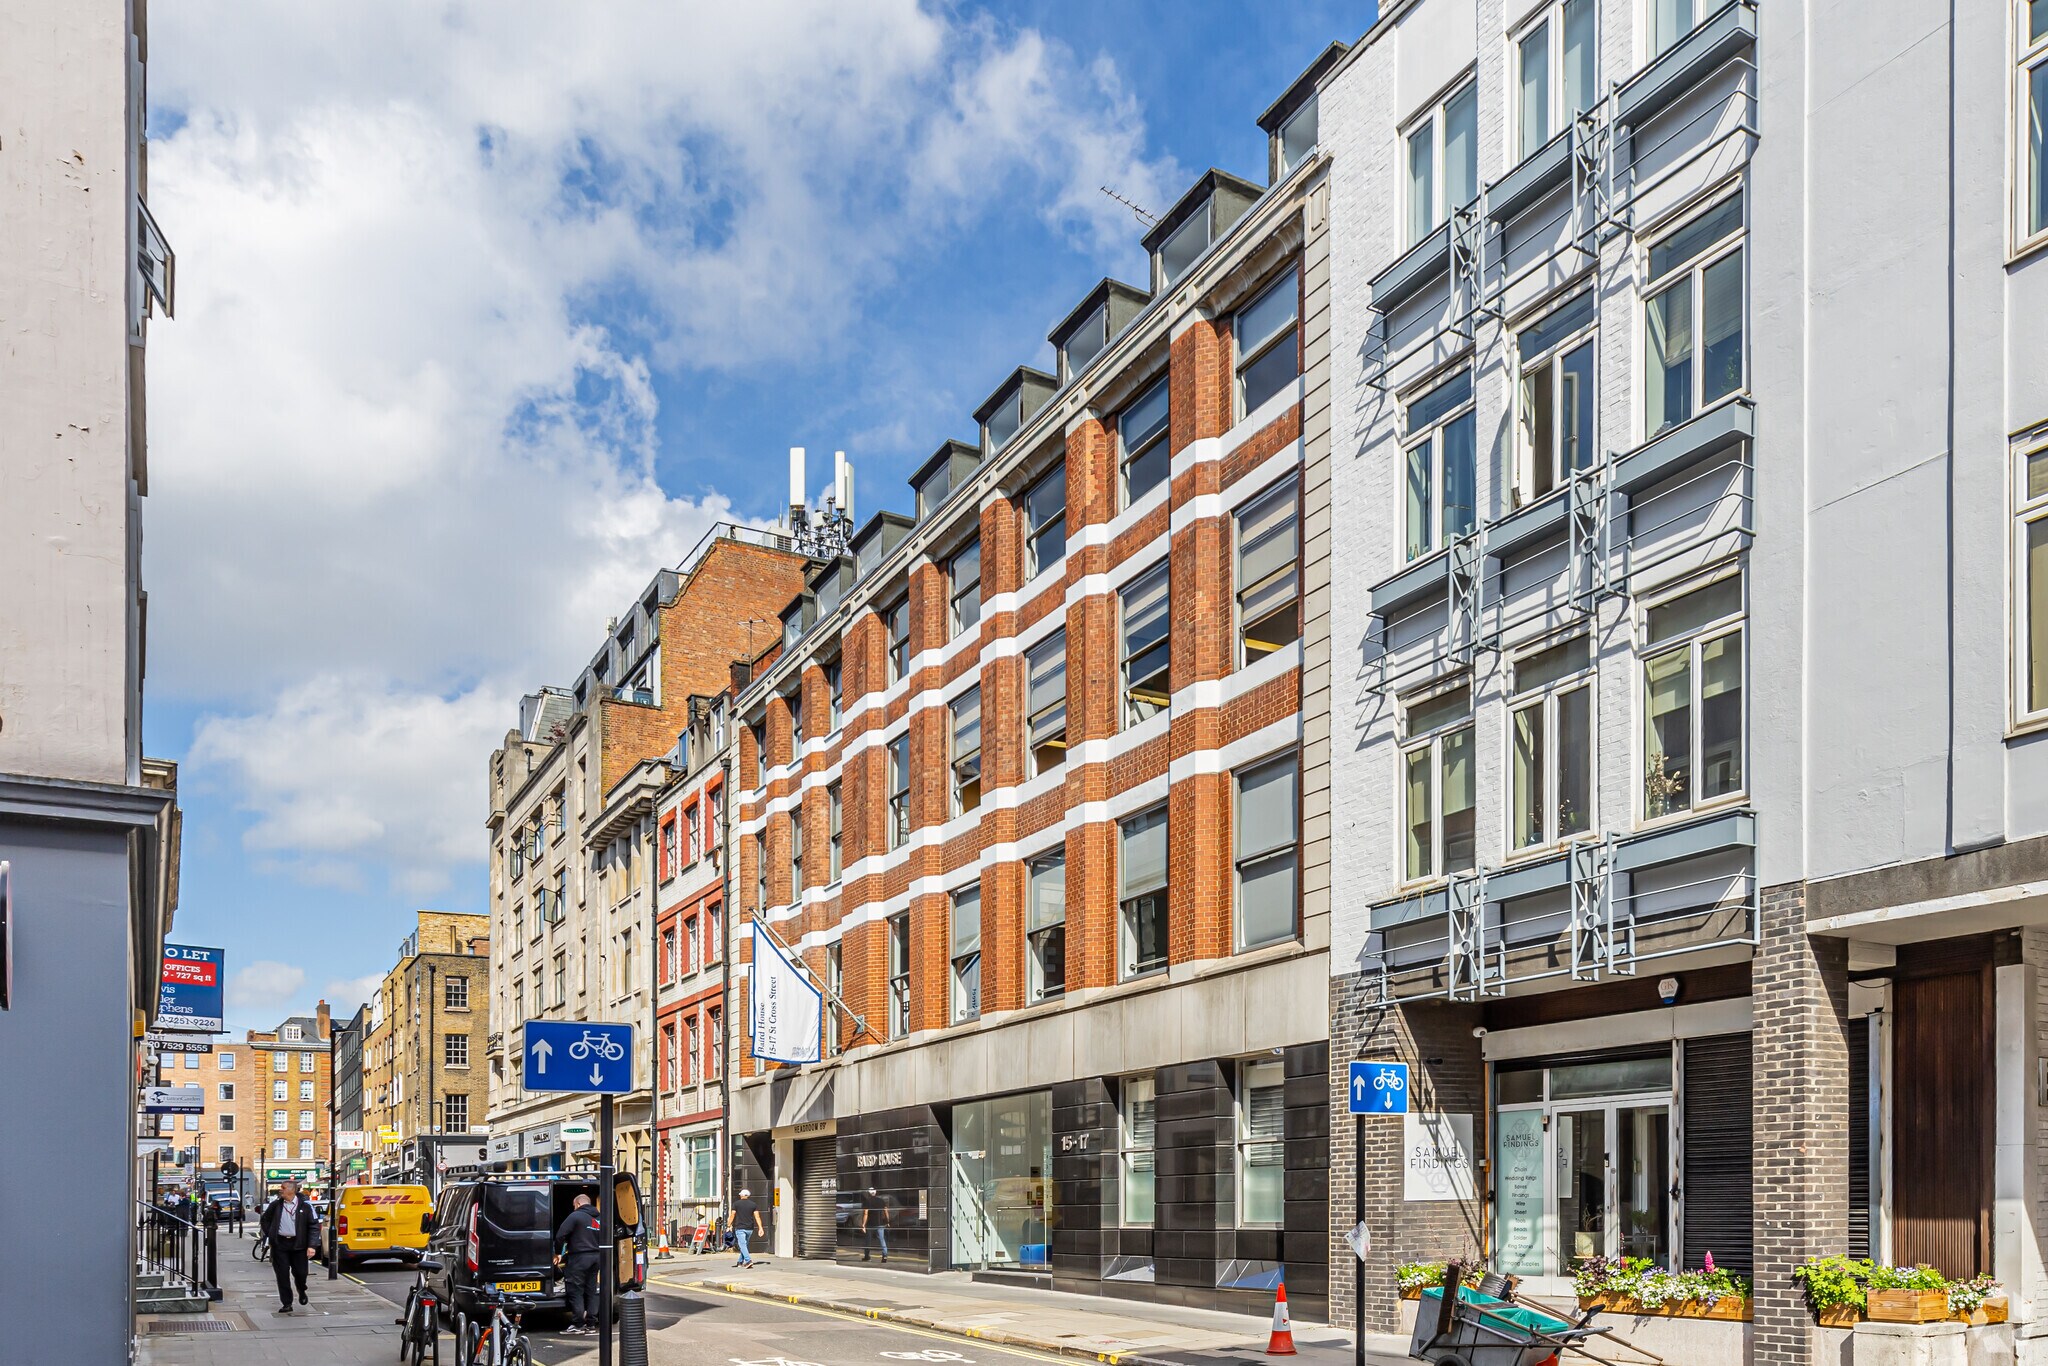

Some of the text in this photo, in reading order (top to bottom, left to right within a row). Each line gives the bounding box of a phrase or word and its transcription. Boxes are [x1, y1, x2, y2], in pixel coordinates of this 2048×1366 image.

[182, 949, 210, 961] LET
[164, 964, 201, 973] OFFICES
[176, 972, 191, 980] 727
[769, 976, 777, 999] Street
[158, 1003, 194, 1014] phens
[769, 1001, 777, 1024] Cross
[757, 1002, 765, 1053] Baird House
[161, 1042, 184, 1051] 7529
[185, 1044, 208, 1052] 5555
[793, 1122, 819, 1133] HEADROOM
[532, 1132, 550, 1142] WALSH
[1505, 1133, 1536, 1141] SAMUEL
[495, 1141, 509, 1150] WALSH
[1503, 1140, 1539, 1148] FINDINGS
[1415, 1146, 1464, 1157] SAMUEL
[879, 1152, 902, 1166] HOUSE
[1410, 1158, 1470, 1169] FINDINGS
[361, 1195, 414, 1205] DHL
[520, 1282, 538, 1290] WSD
